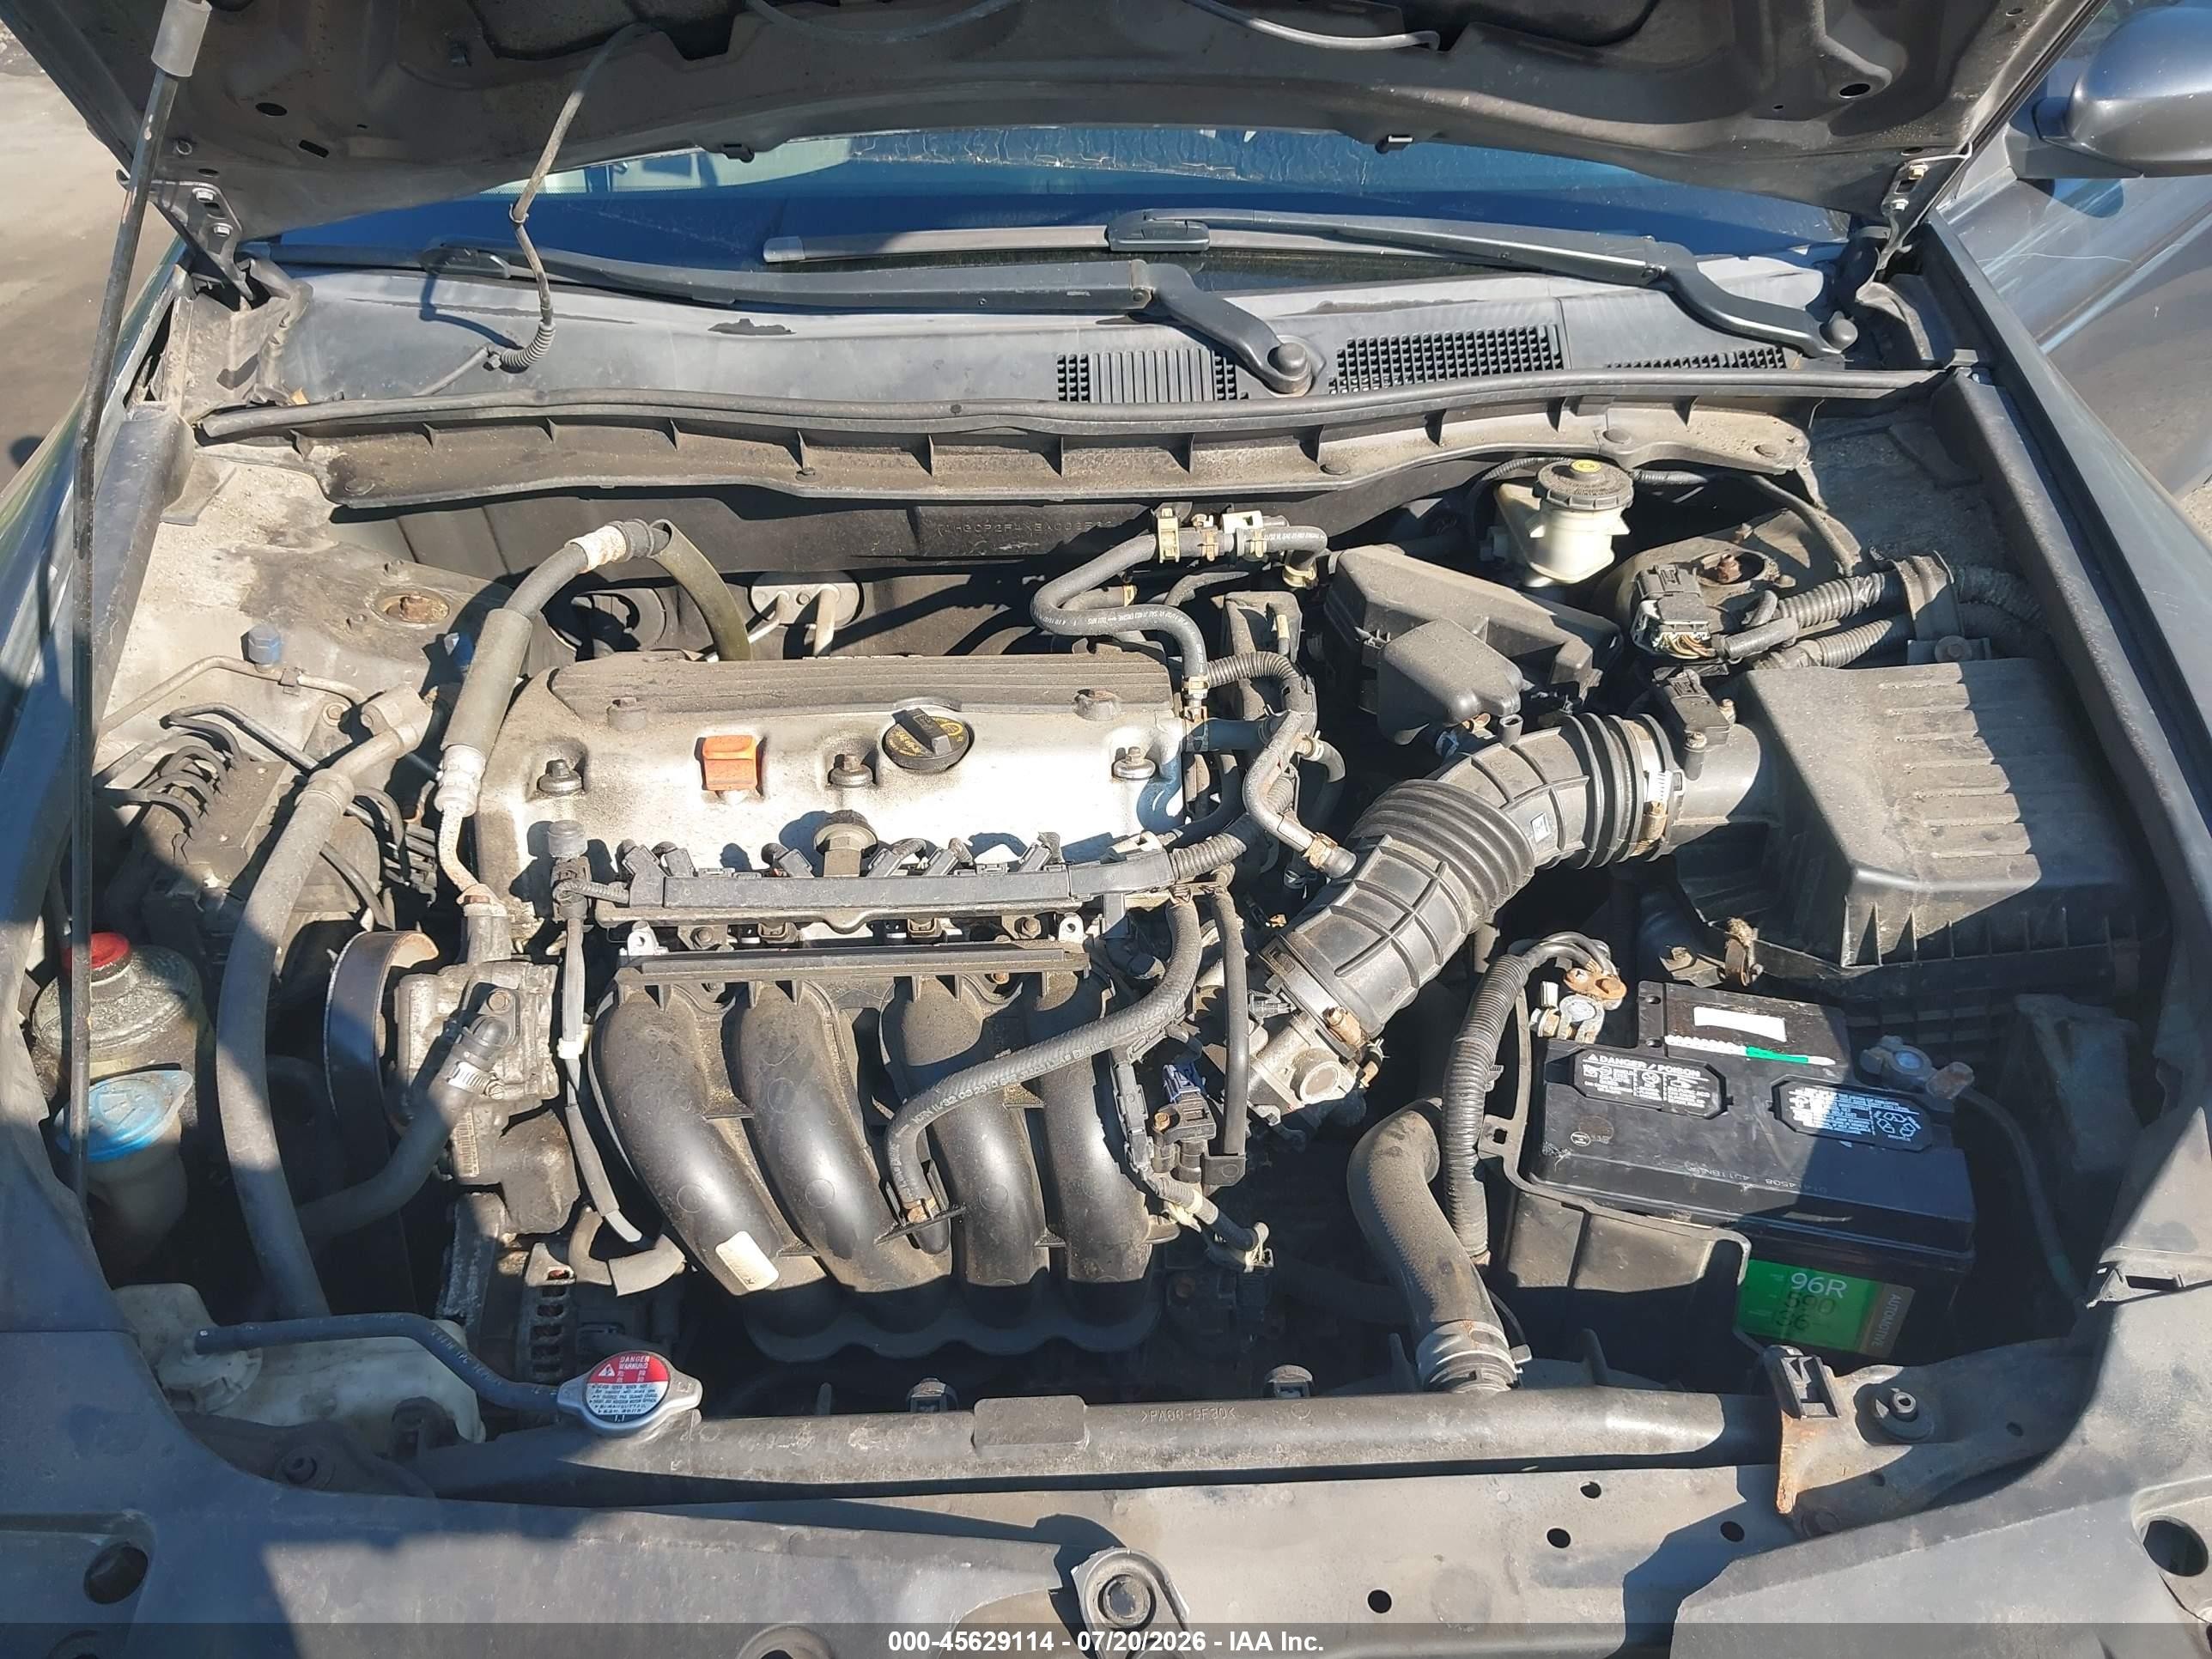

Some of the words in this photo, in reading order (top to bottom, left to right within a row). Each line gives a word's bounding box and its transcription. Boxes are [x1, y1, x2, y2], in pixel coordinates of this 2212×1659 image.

[1600, 1055, 1648, 1069] DANGER
[1657, 1064, 1701, 1078] POISON
[1791, 1272, 1847, 1298] 96R
[1785, 1291, 1837, 1316] 590
[1871, 1293, 1903, 1347] AUTOMOTIVE
